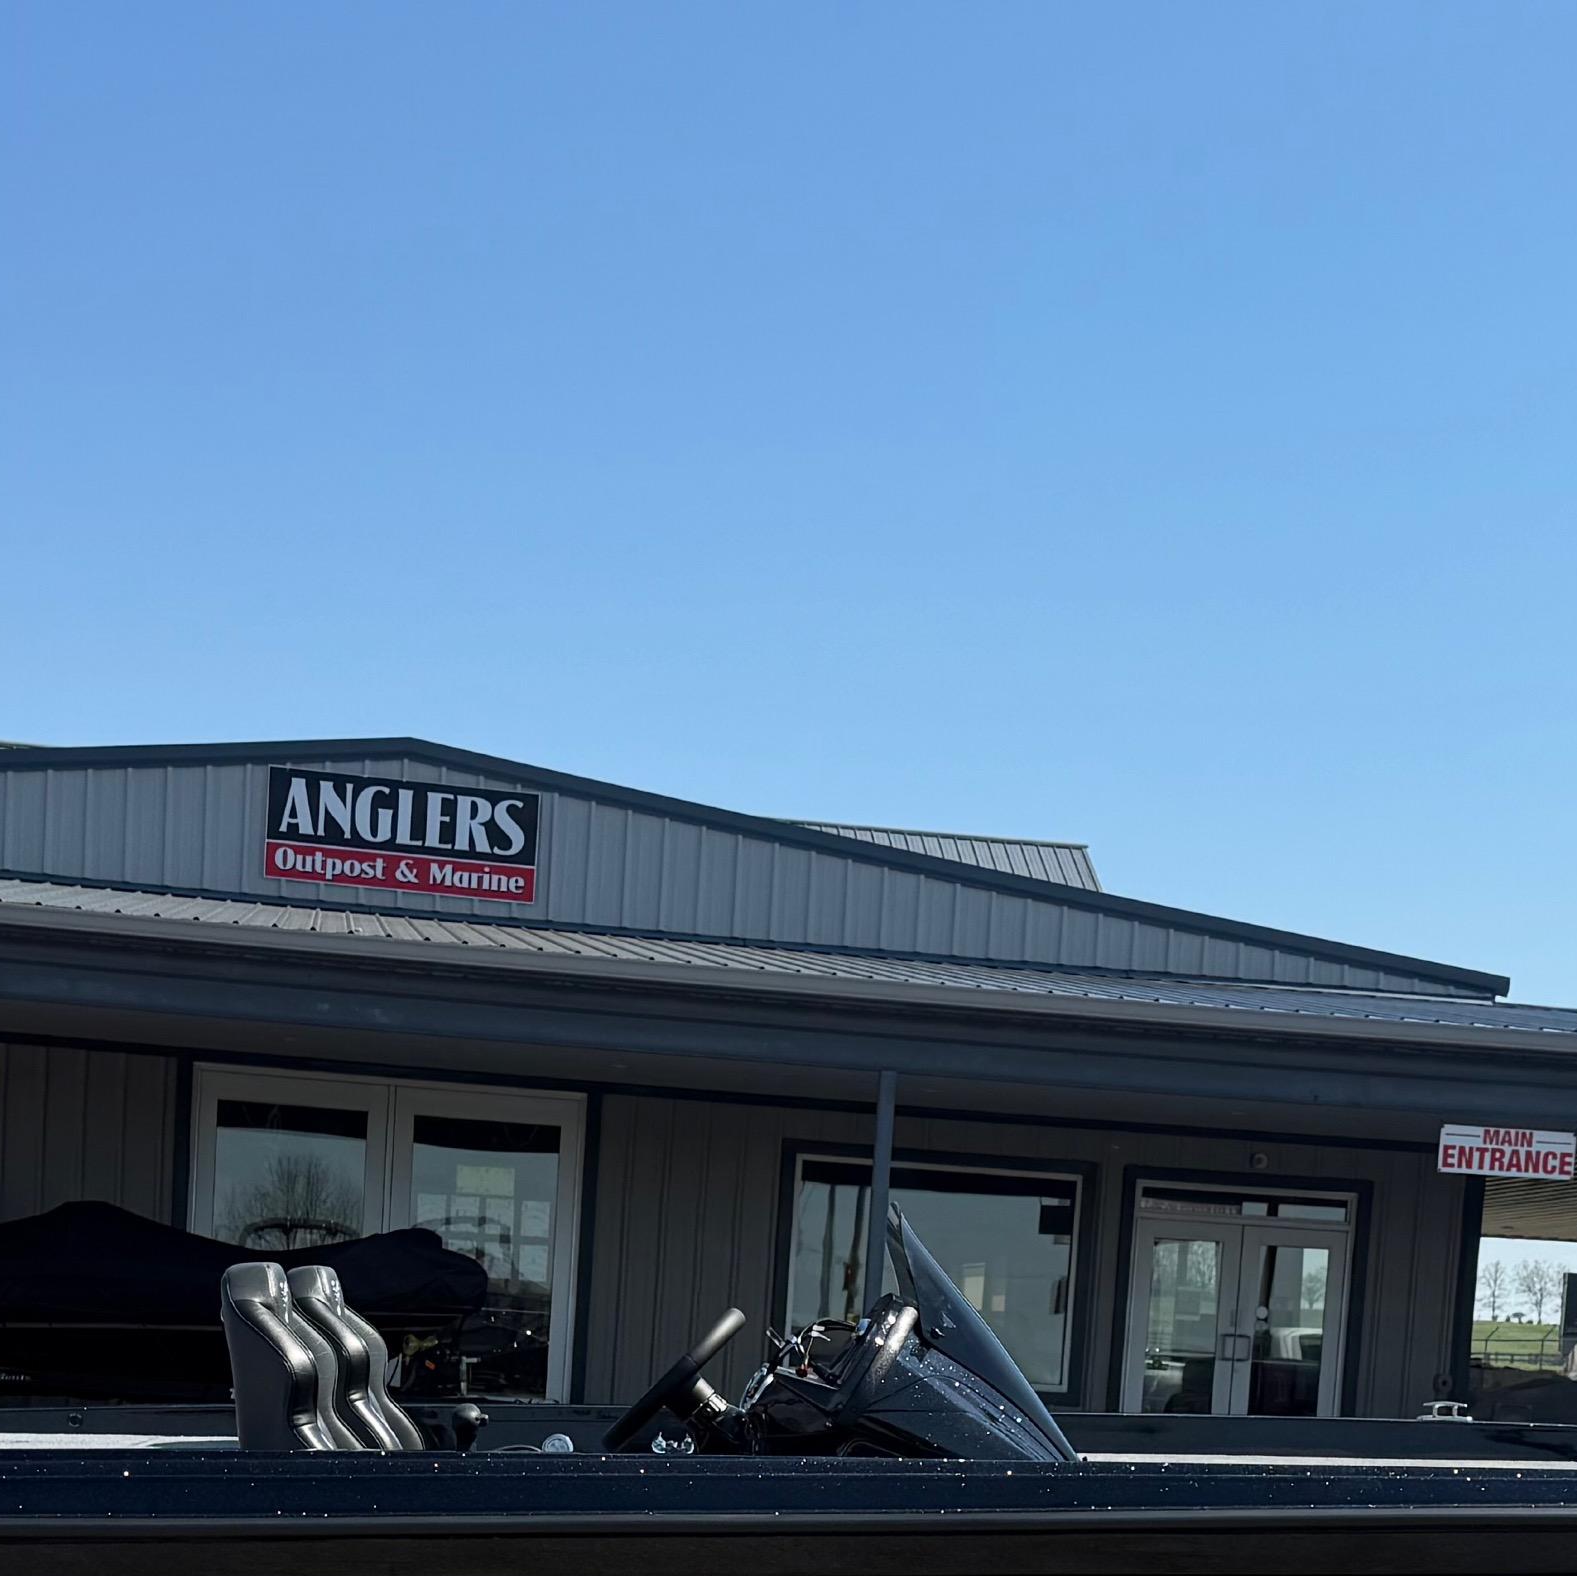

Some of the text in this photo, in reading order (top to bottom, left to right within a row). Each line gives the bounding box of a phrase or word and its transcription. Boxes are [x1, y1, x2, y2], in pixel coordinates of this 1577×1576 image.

[278, 777, 525, 857] ANGLERS
[274, 847, 525, 894] Outpost & Marine
[1482, 1128, 1534, 1148] MAIN
[1442, 1145, 1573, 1176] ENTRANCE
